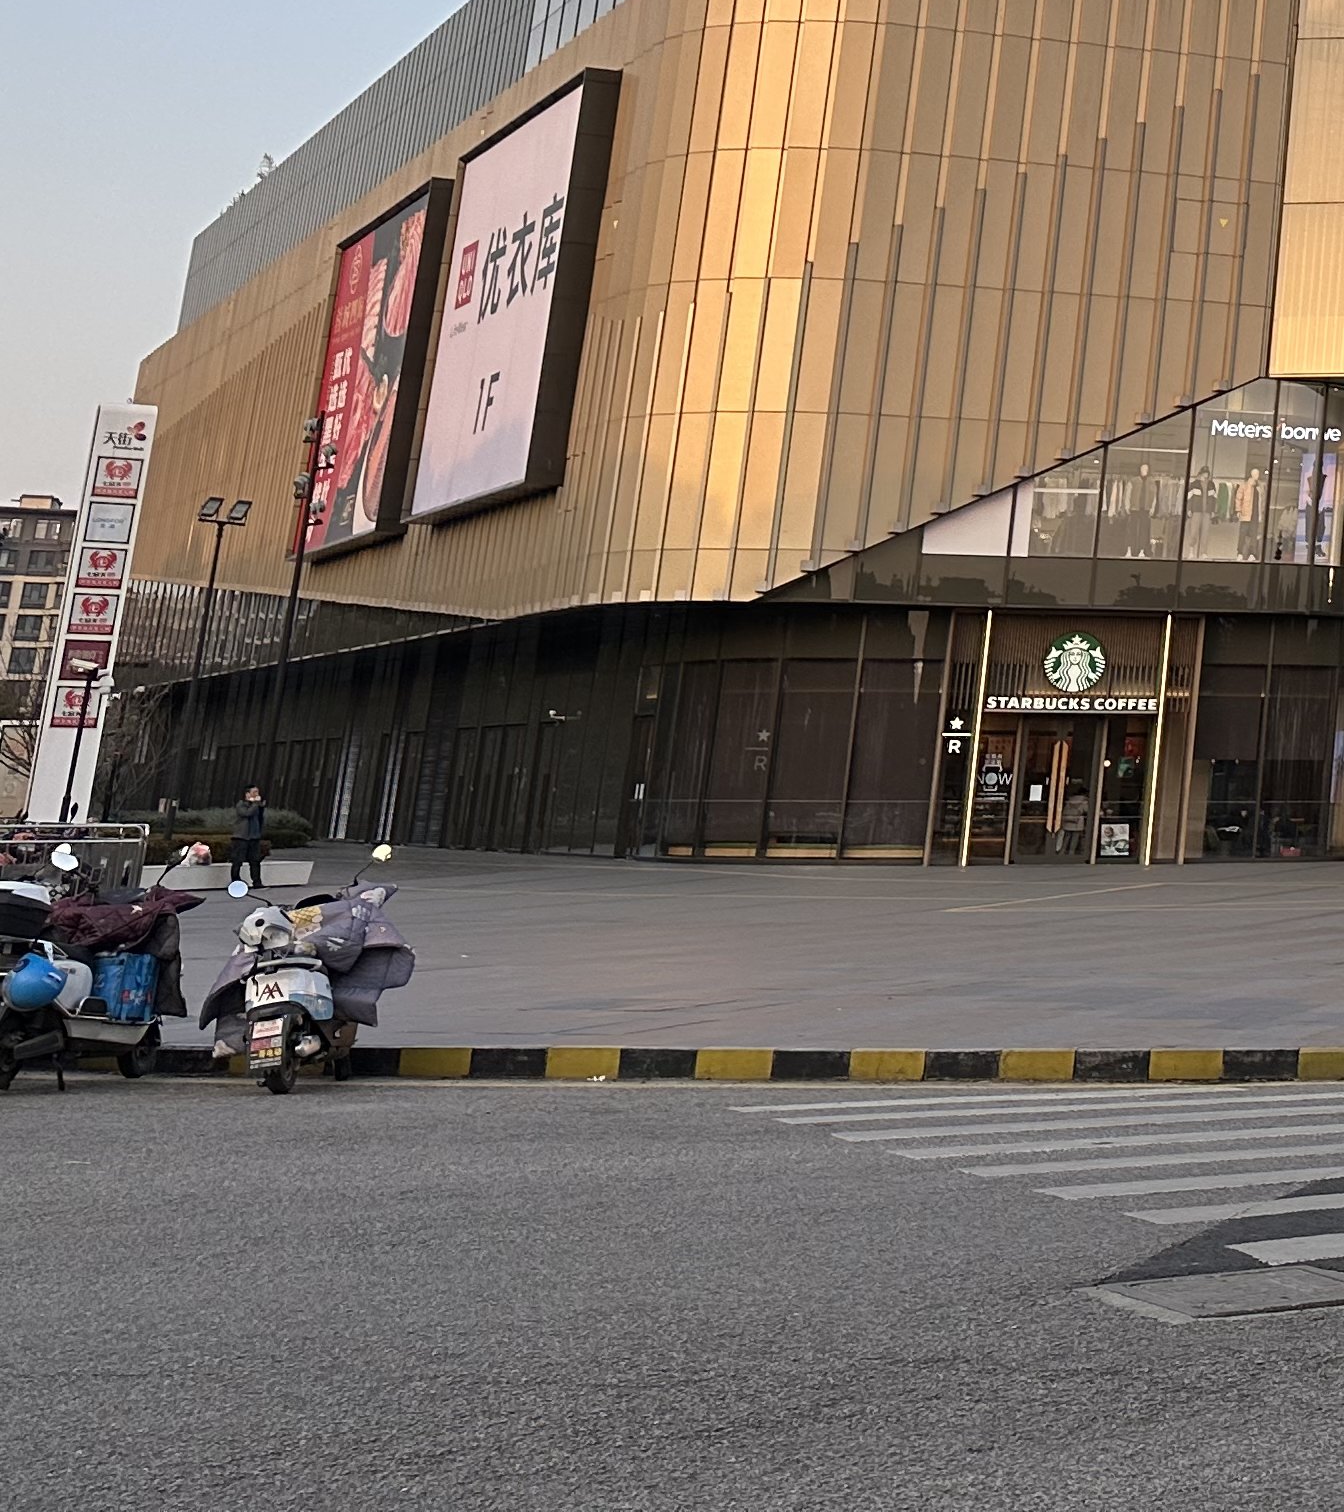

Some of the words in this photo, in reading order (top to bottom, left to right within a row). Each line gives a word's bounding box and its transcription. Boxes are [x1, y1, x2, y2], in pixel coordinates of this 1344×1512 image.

[477, 192, 565, 324] 优衣库
[1211, 419, 1272, 438] Meters
[1281, 423, 1342, 441] bone
[103, 431, 132, 446] 天街
[986, 696, 1090, 710] STARBUCKS
[1094, 697, 1157, 711] COFFEE
[948, 739, 961, 754] R
[754, 755, 768, 771] R
